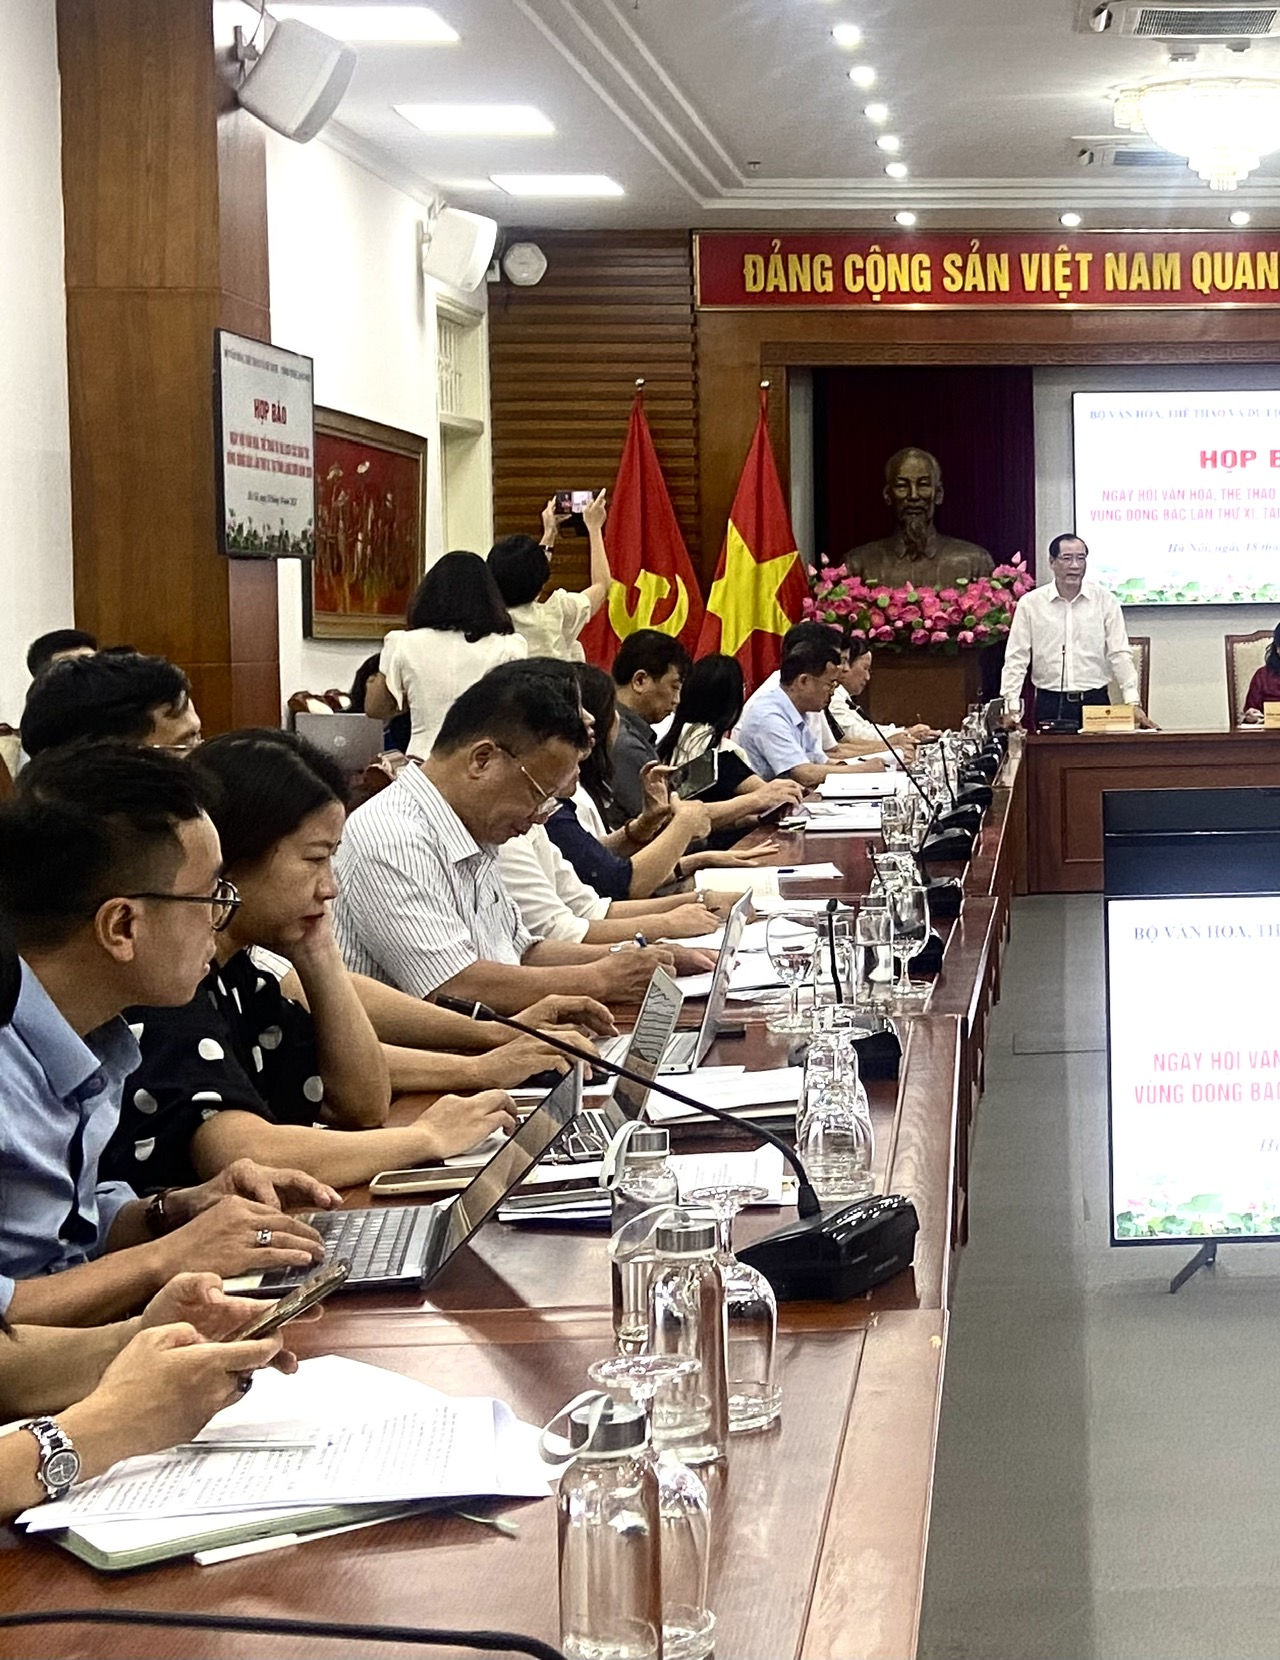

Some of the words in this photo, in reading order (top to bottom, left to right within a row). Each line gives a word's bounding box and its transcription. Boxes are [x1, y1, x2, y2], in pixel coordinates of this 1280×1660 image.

[743, 240, 834, 293] ĐẢNG
[844, 245, 932, 301] CỘNG
[942, 240, 1009, 292] SẢN
[1020, 246, 1093, 300] VIỆT
[1104, 252, 1181, 291] NAM
[1199, 449, 1258, 474] HỌP
